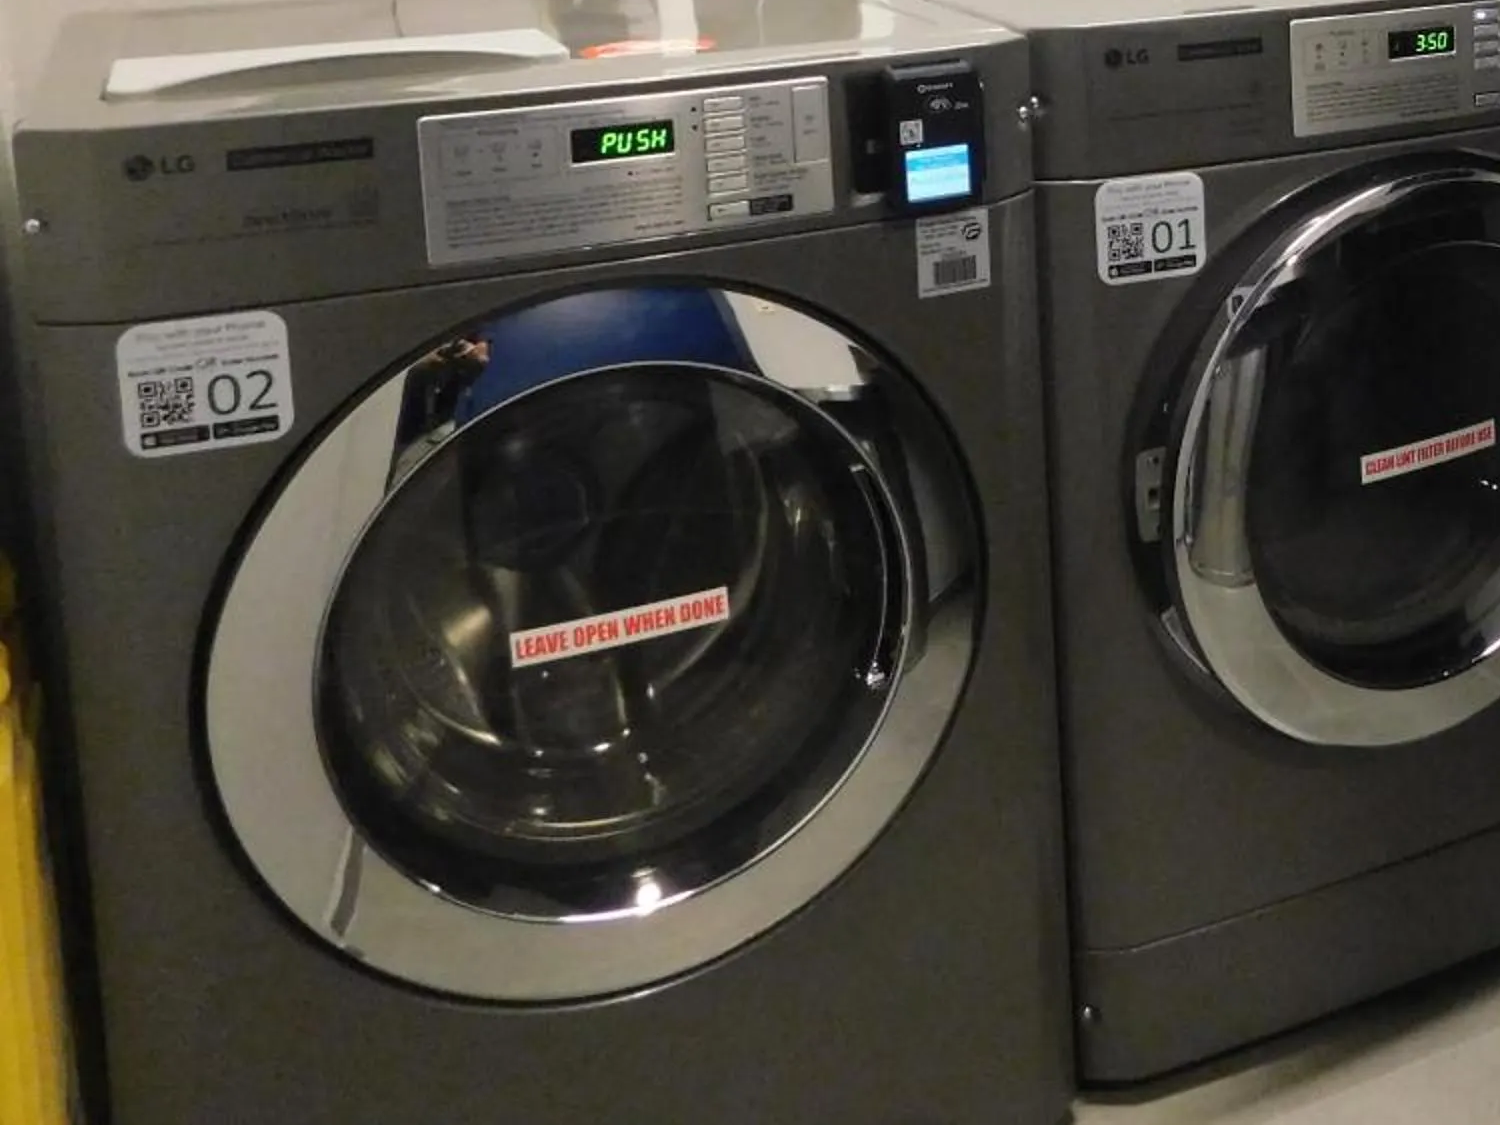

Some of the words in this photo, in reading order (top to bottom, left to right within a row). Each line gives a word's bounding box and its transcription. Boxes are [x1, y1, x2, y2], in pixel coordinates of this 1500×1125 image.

[1126, 48, 1150, 65] LG
[601, 129, 667, 154] PUSH
[160, 155, 196, 175] LG
[1151, 219, 1197, 254] 01
[207, 369, 279, 416] 02
[1364, 455, 1396, 476] CLEAN
[1417, 441, 1445, 462] FILTER
[514, 632, 569, 660] LEAVE
[573, 618, 619, 648] OPEN
[623, 604, 676, 636] WHEN
[679, 594, 725, 623] DONE
